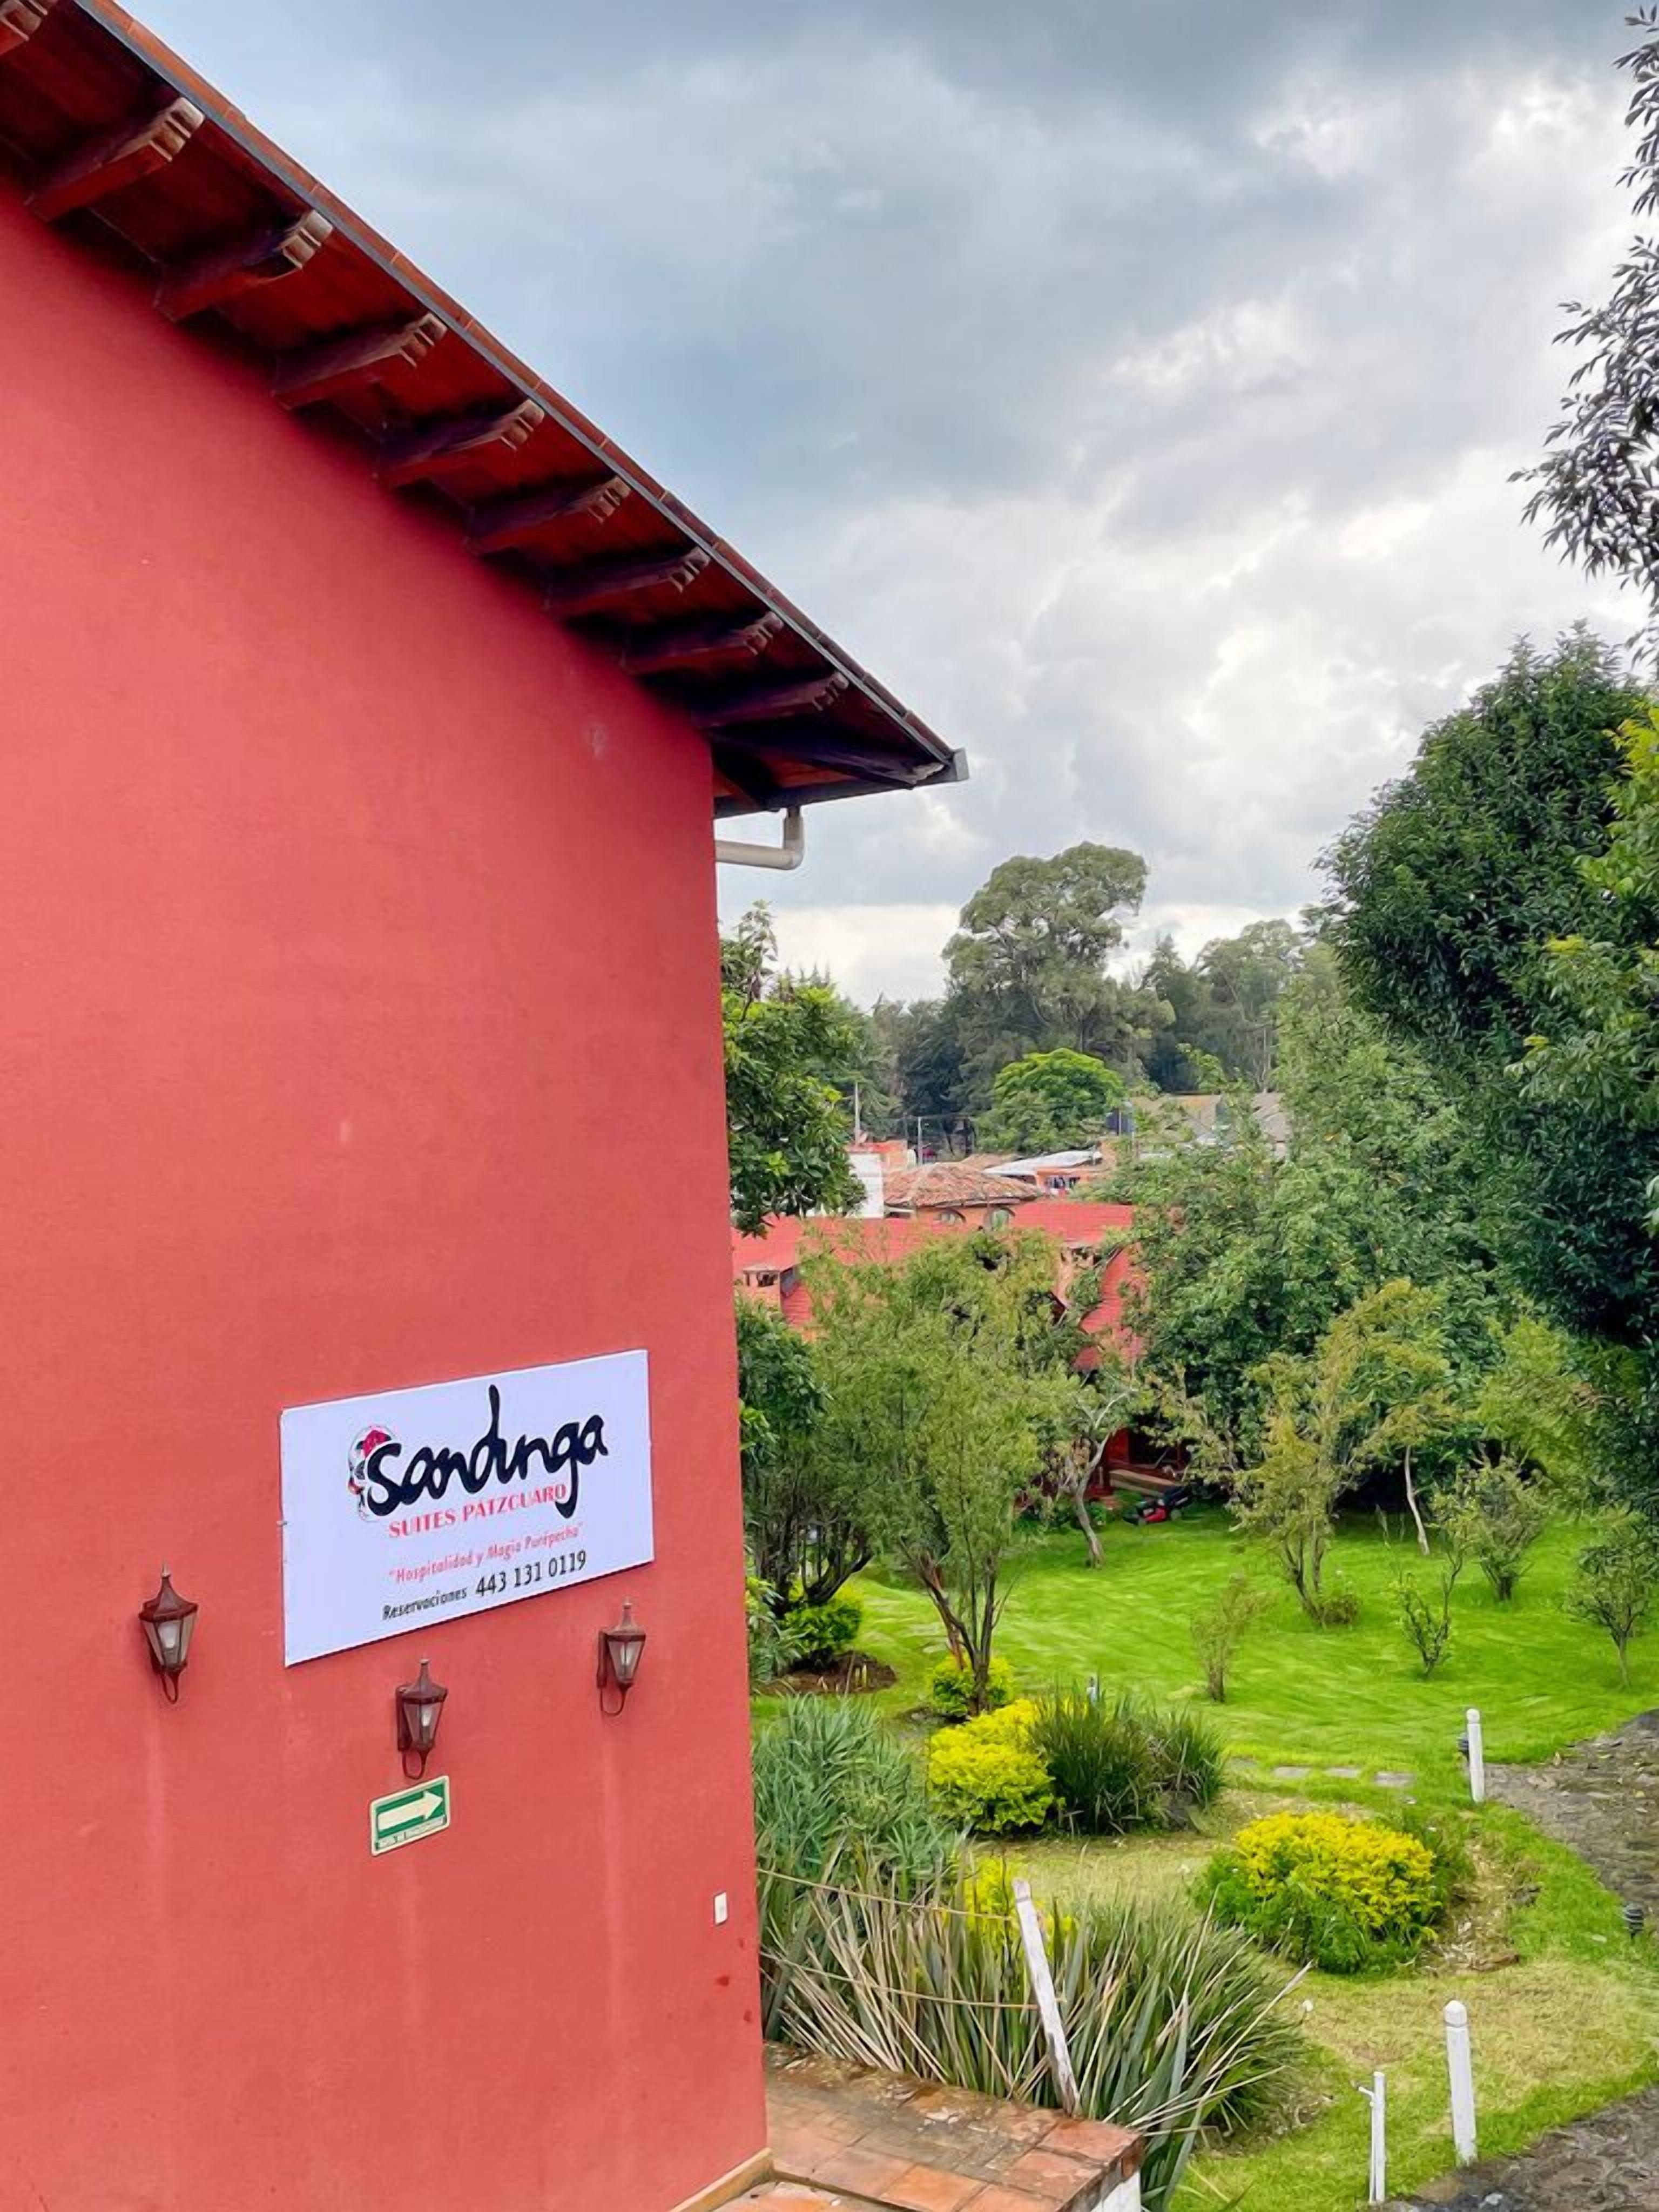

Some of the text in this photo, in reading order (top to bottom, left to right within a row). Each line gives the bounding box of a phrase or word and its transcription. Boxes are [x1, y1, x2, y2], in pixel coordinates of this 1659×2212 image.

[367, 1384, 609, 1518] Sandunga
[388, 1508, 456, 1538] SUITES
[475, 1552, 484, 1568] y
[488, 1541, 521, 1561] Magia
[382, 1548, 586, 1620] Reservaciones 443 131 0119
